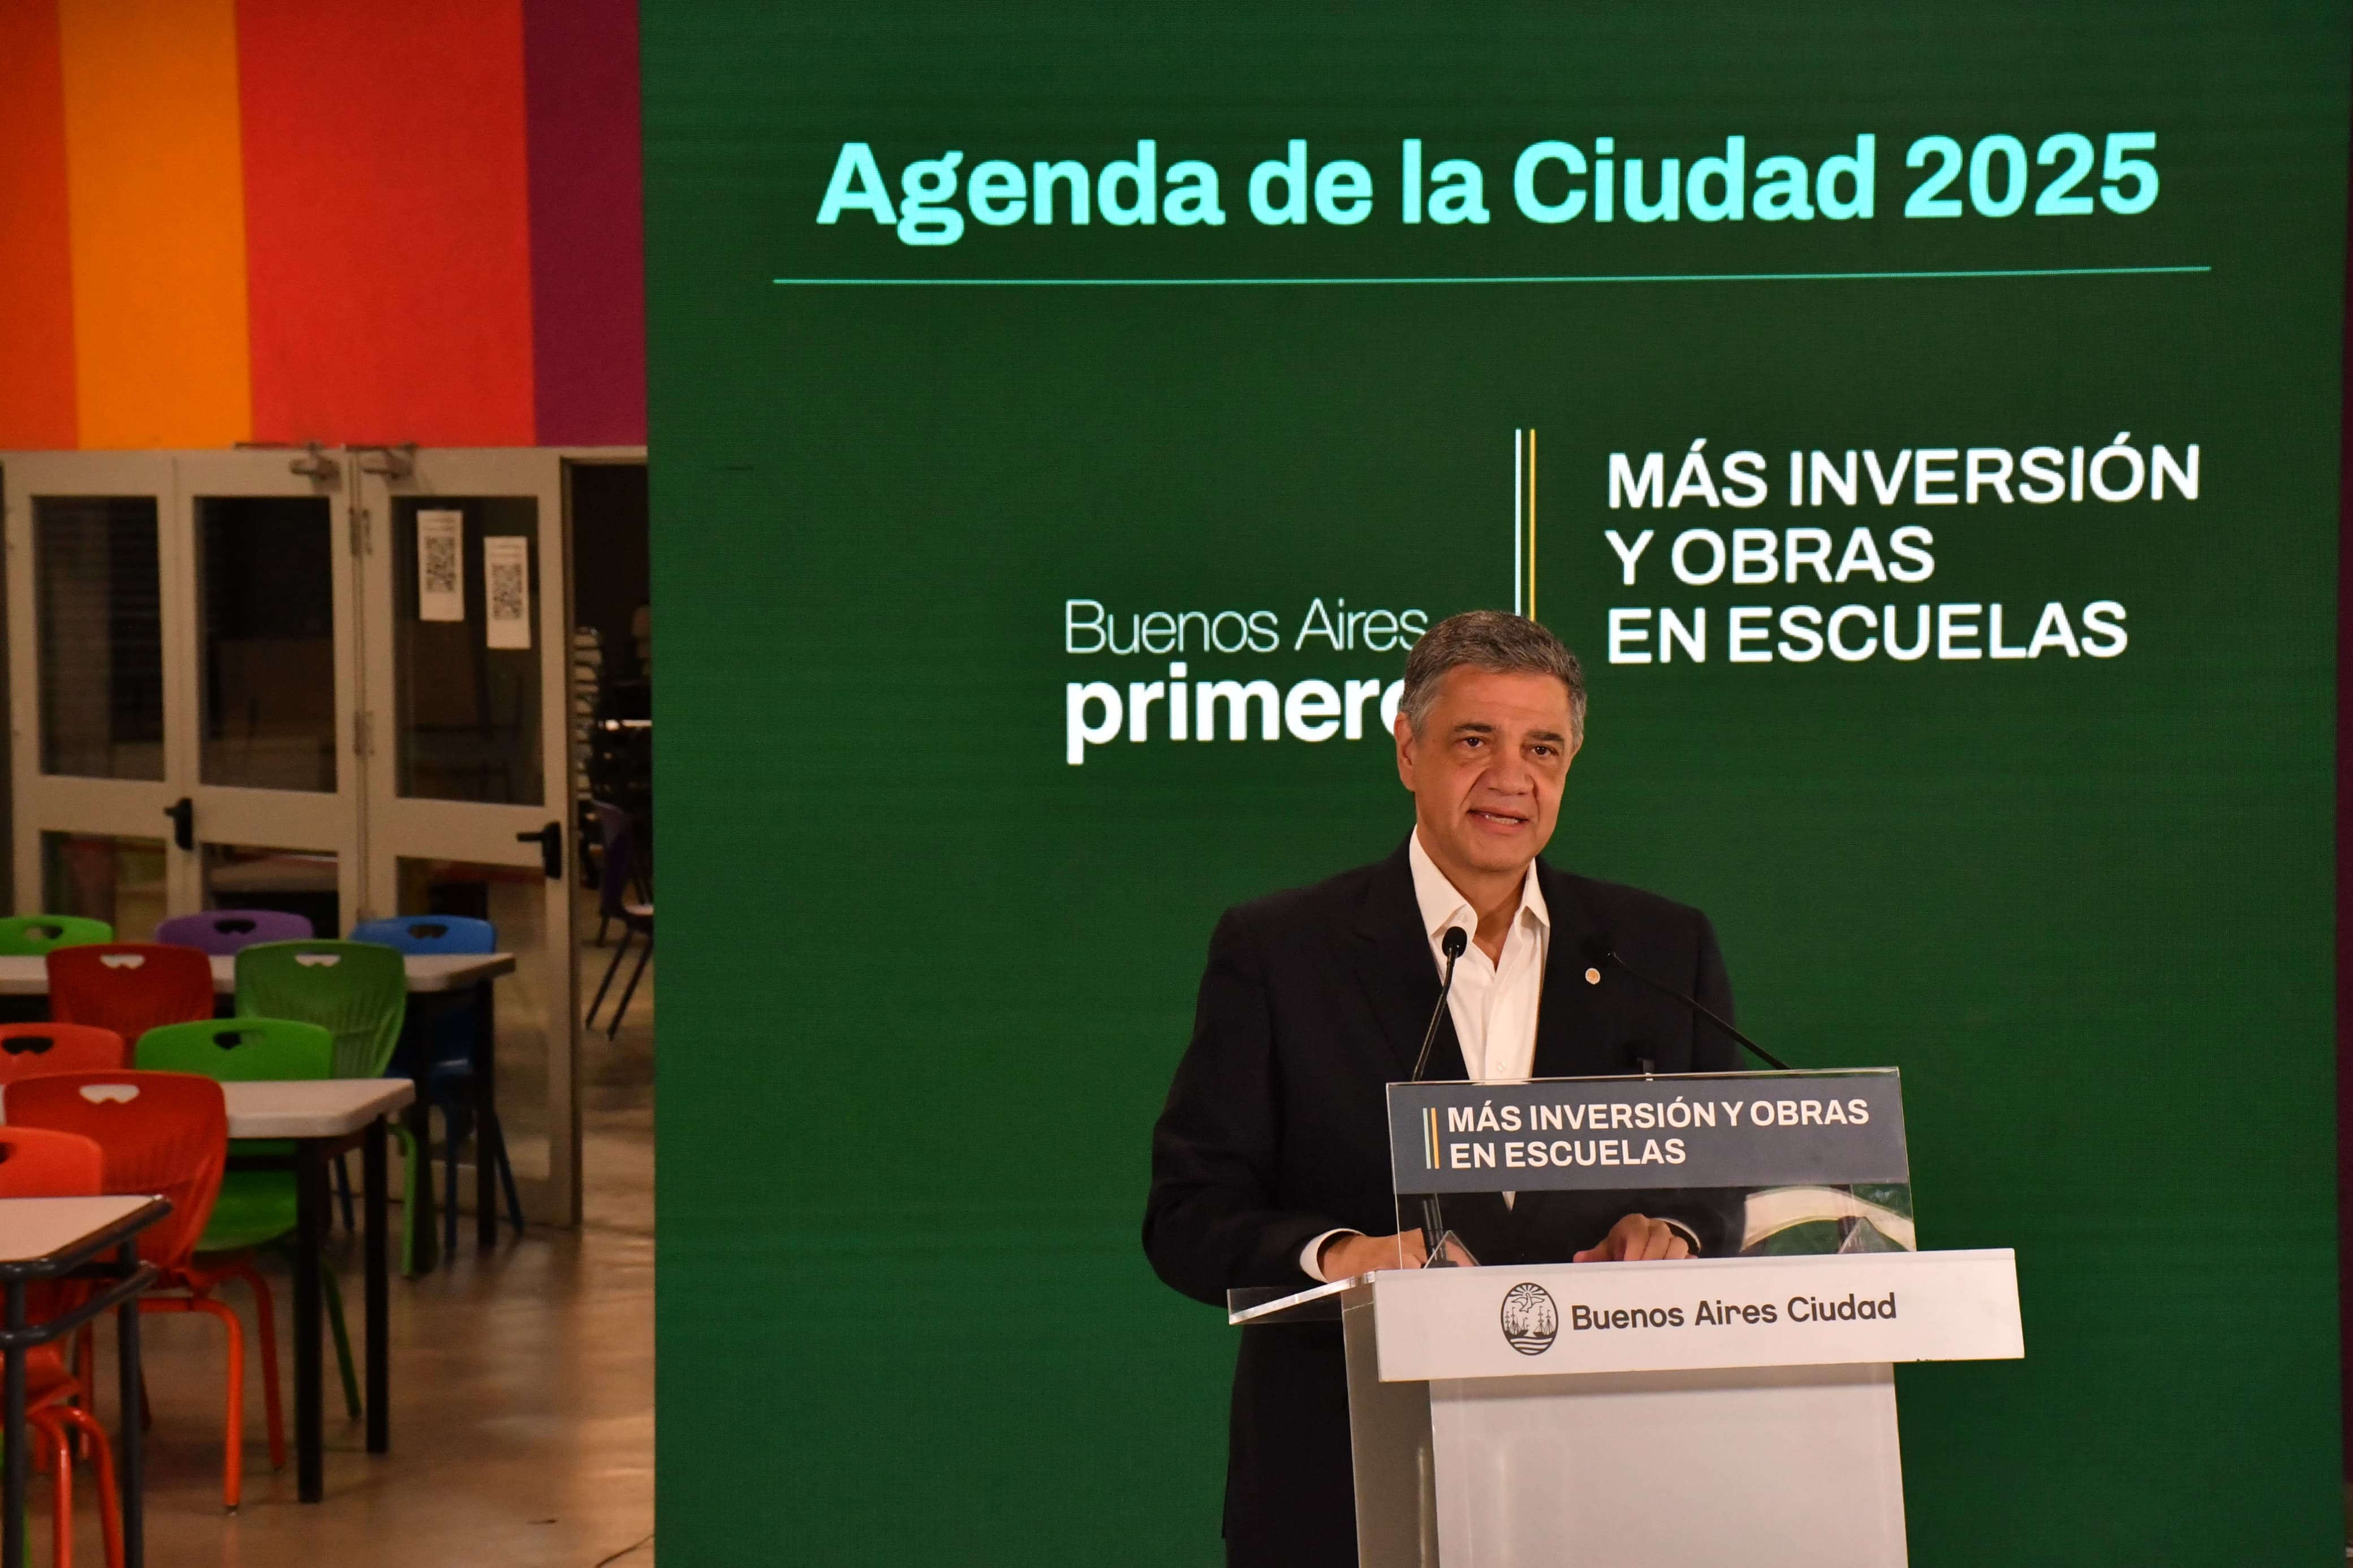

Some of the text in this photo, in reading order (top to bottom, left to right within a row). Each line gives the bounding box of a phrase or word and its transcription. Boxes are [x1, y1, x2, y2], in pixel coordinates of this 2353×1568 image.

[816, 132, 2158, 245] Agenda de la Ciudad 2025
[1609, 431, 2199, 509] MÁS INVERSIÓN
[1605, 526, 1935, 585] Y OBRAS
[1066, 597, 1428, 655] Buenos Aires
[1608, 601, 2128, 664] EN ESCUELAS
[1447, 1096, 1869, 1132] MÁS INVERSIÓN Y OBRAS
[1450, 1138, 1686, 1169] EN ESCUELAS
[1572, 1292, 1897, 1330] Buenos Aires Ciudad
